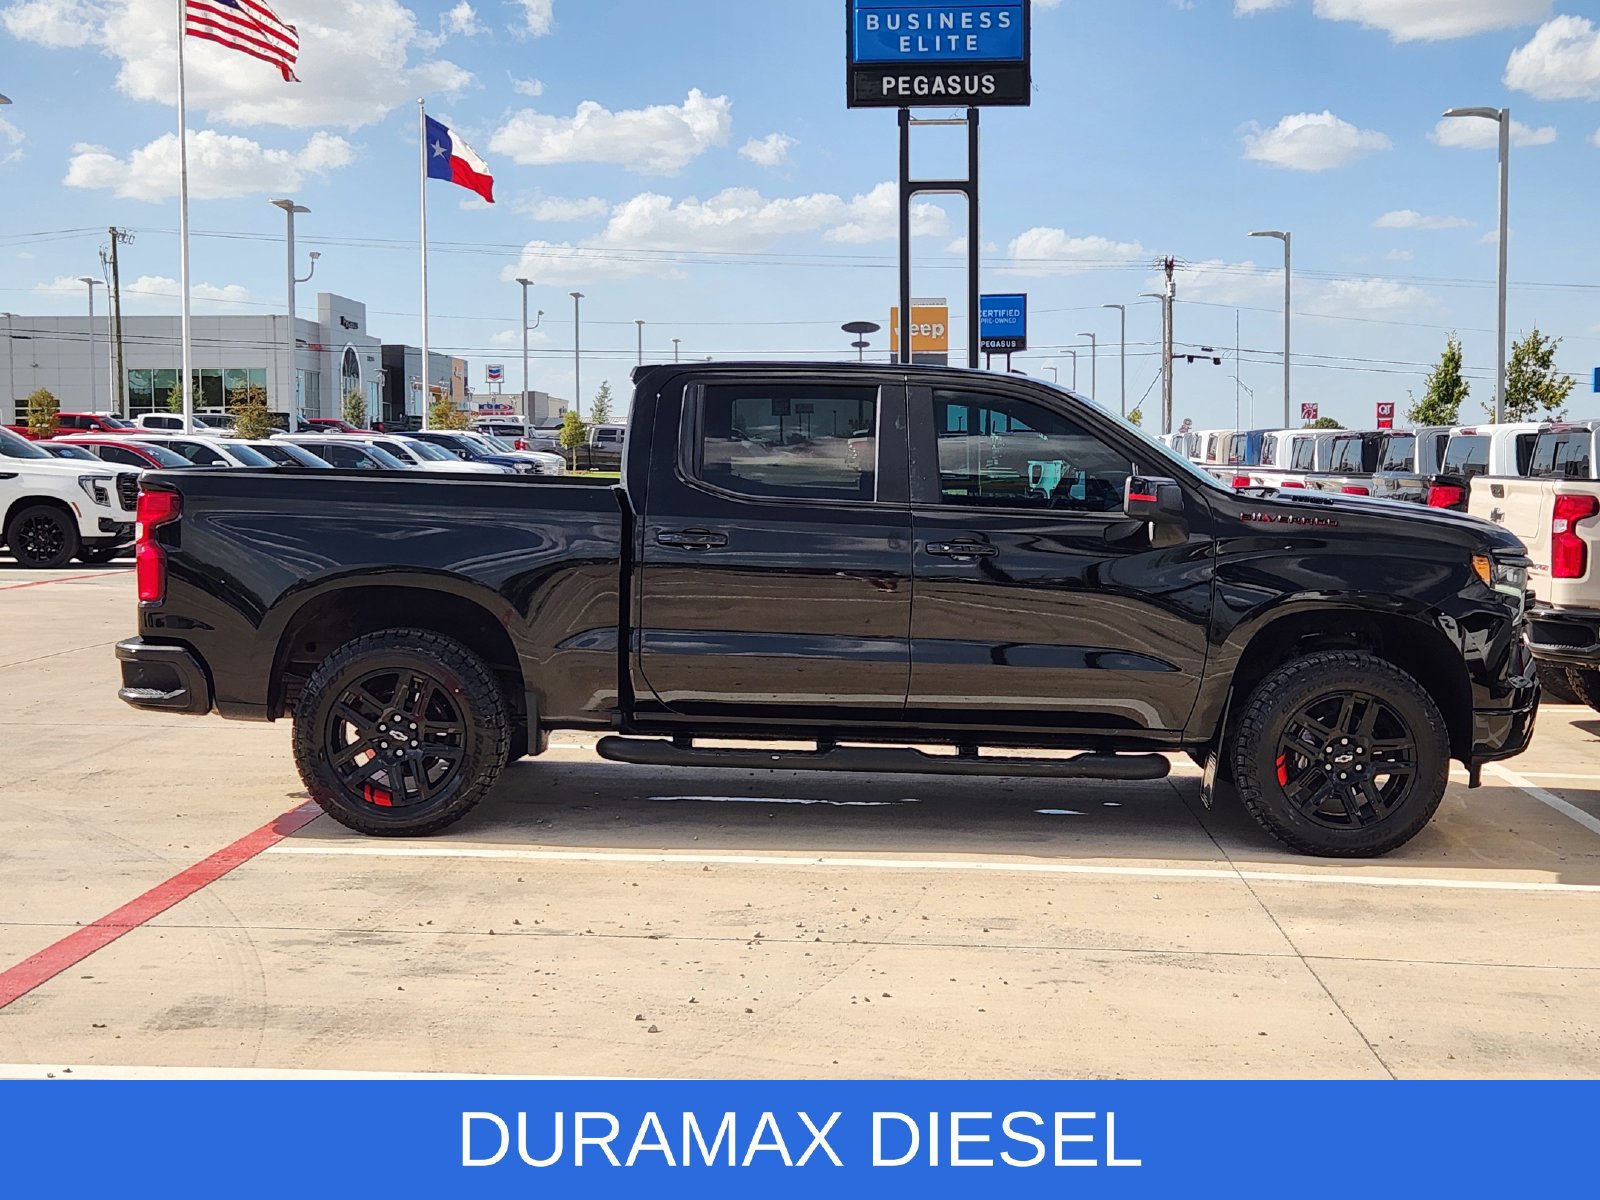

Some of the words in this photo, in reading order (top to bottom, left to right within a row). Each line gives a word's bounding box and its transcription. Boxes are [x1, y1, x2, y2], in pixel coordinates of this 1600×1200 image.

[866, 11, 1011, 30] BUSINESS
[900, 35, 978, 52] ELITE
[882, 75, 996, 95] PEGASUS
[980, 340, 1016, 348] PEGASUS
[1379, 404, 1391, 415] QT
